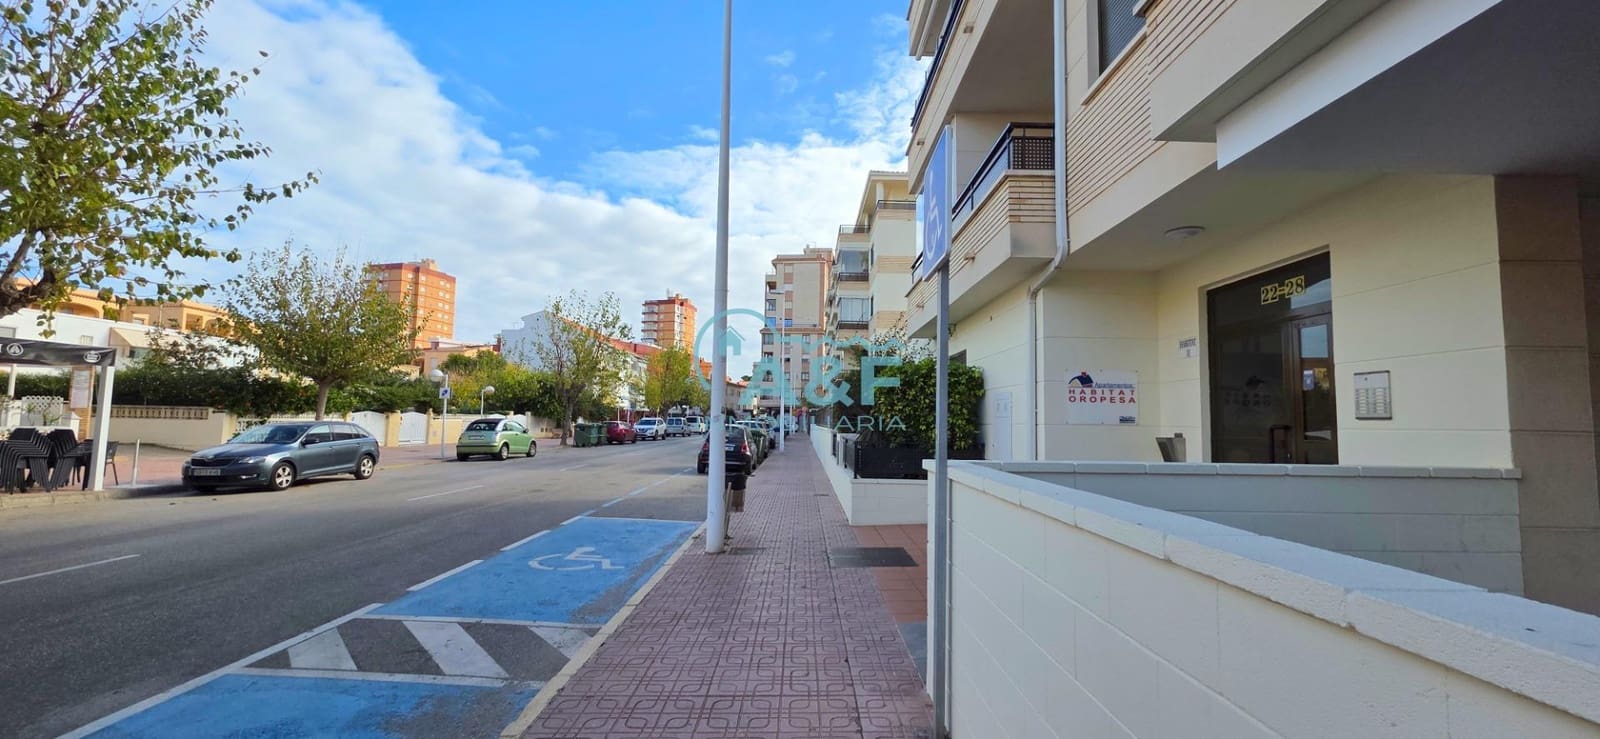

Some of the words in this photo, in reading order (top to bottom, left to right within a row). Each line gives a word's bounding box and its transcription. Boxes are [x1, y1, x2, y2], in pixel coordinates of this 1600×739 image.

[1261, 277, 1304, 303] 22-28
[1068, 388, 1136, 396] HABITAT
[1068, 396, 1137, 404] OROPESA
